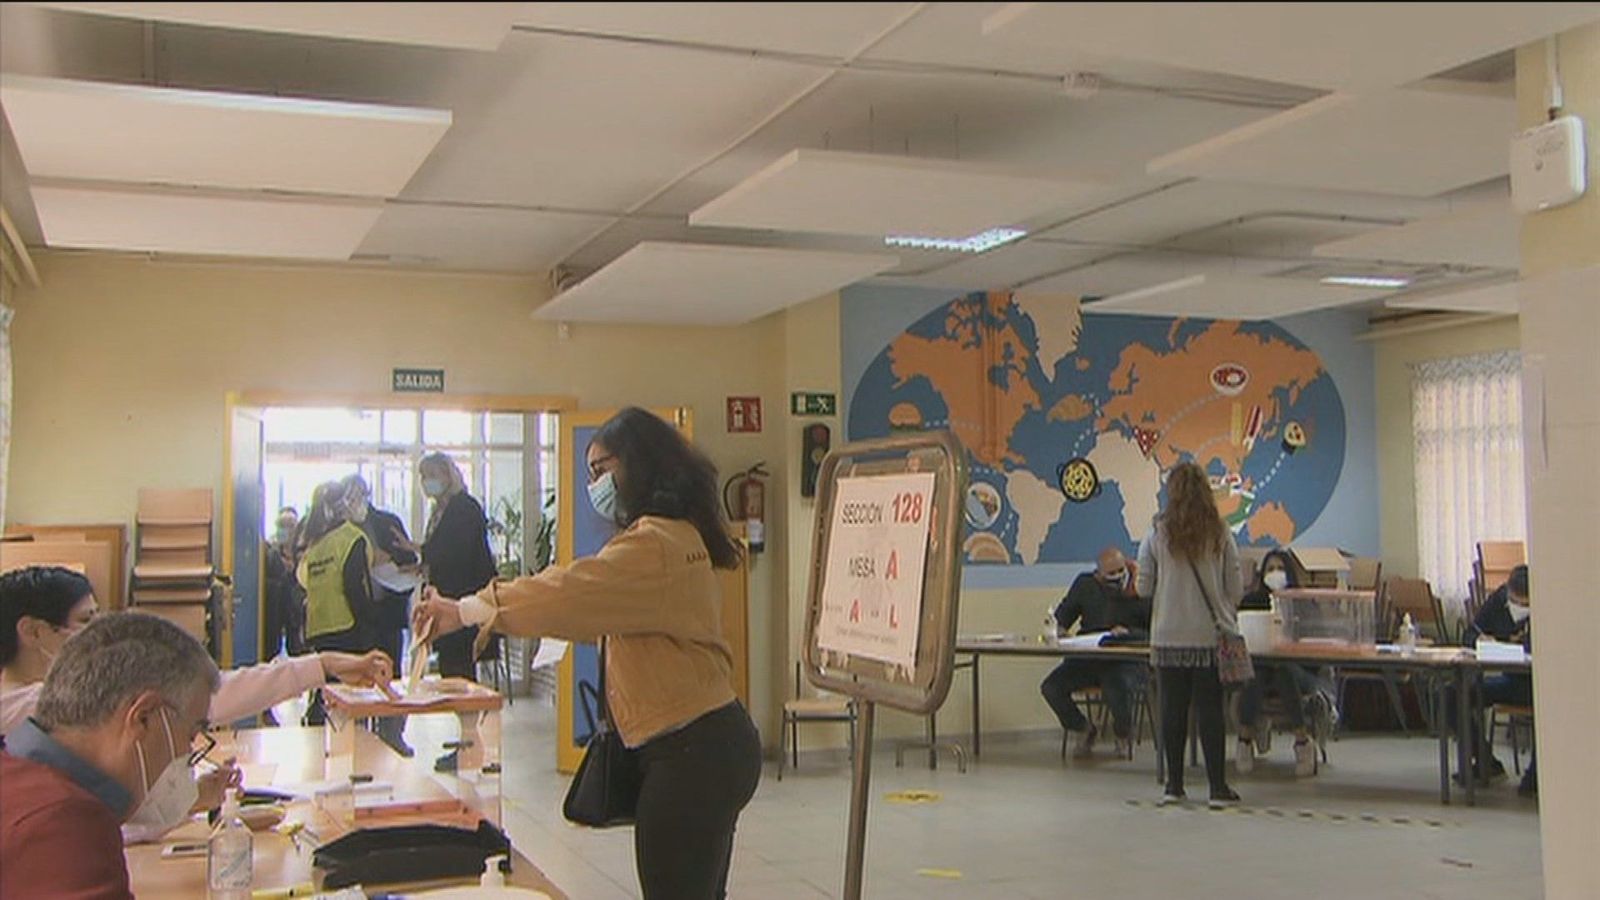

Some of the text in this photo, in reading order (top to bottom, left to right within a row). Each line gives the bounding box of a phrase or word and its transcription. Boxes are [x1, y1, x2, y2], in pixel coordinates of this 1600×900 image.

[395, 374, 442, 389] SALIDA
[892, 492, 923, 524] 128
[849, 550, 898, 580] MESA A
[849, 599, 899, 629] A L
